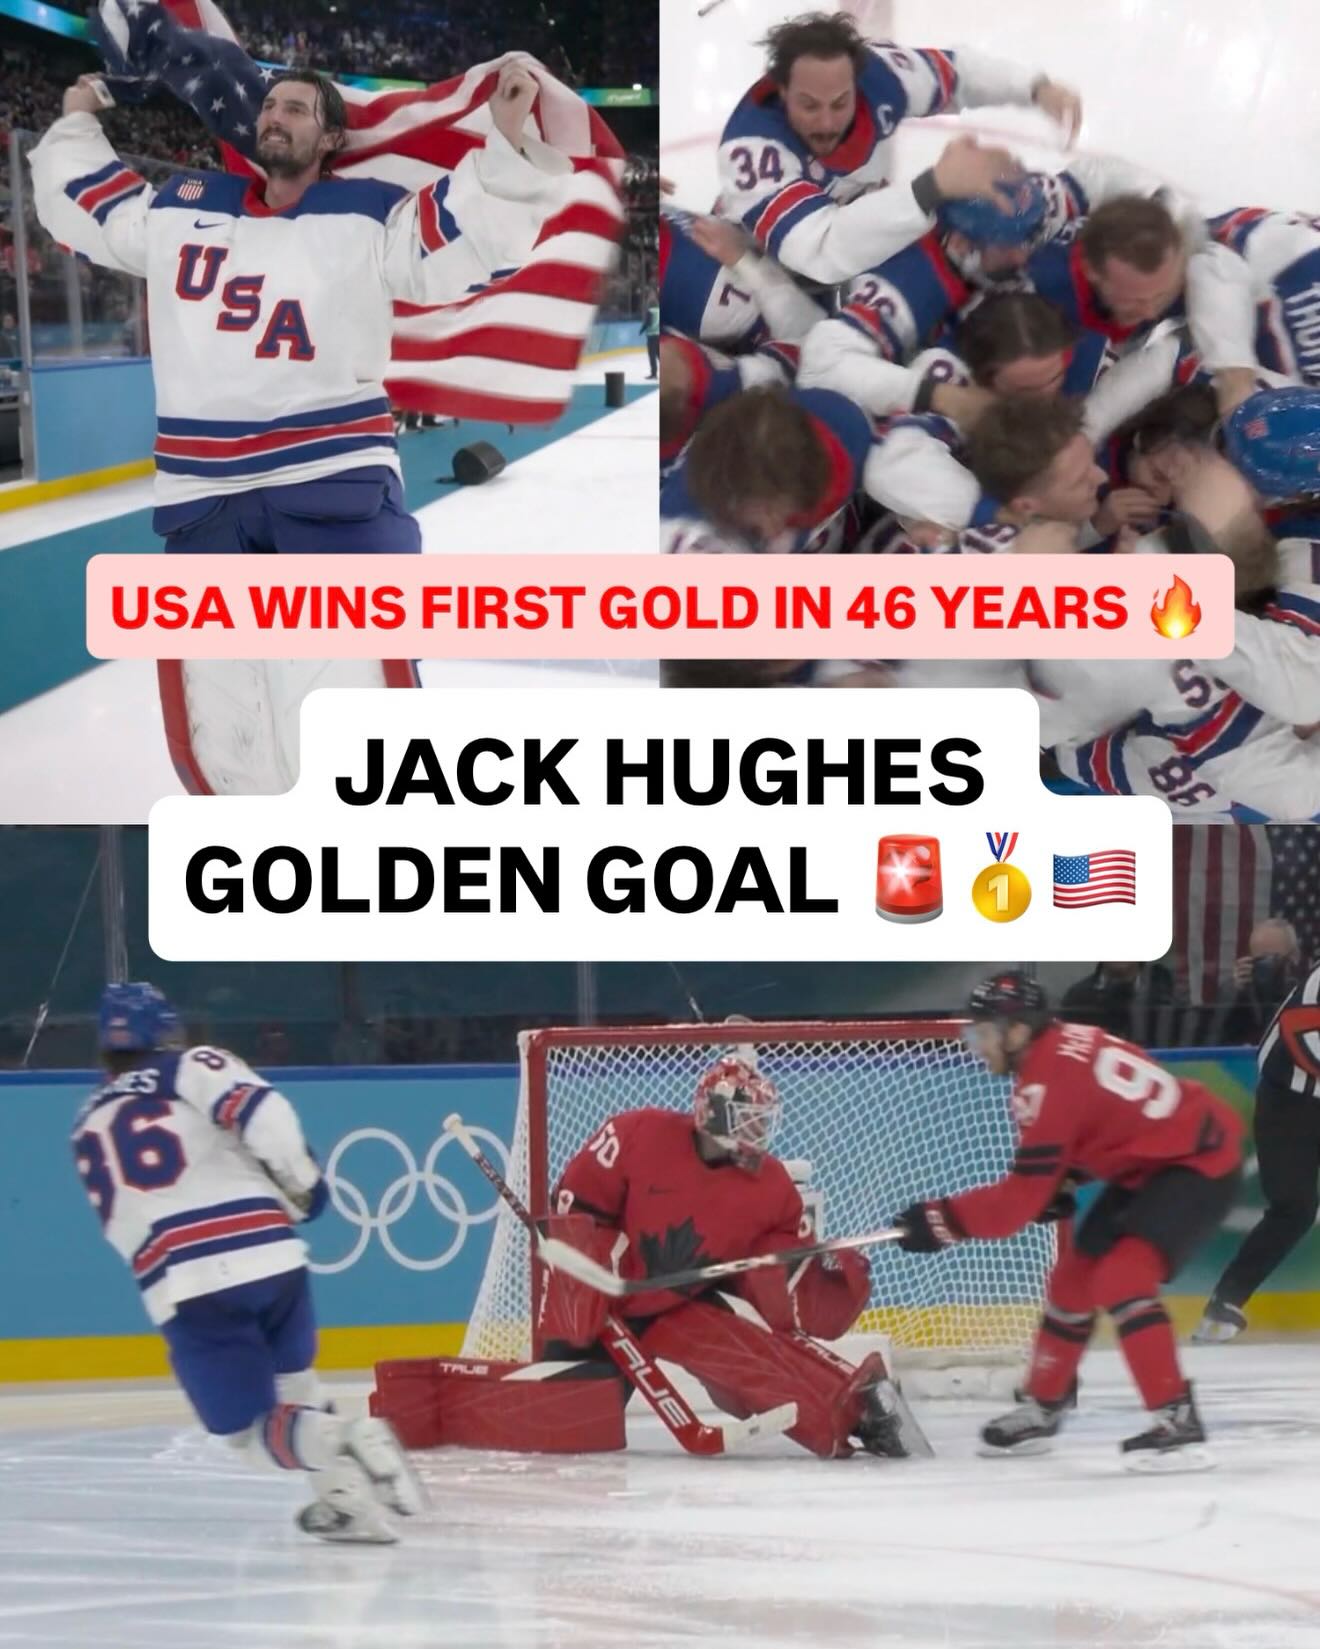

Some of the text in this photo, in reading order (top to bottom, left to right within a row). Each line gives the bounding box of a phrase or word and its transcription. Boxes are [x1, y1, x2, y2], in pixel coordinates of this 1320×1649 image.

[876, 103, 896, 136] C
[730, 145, 785, 191] 34
[175, 243, 316, 362] USA
[719, 282, 751, 307] 7
[1093, 1032, 1182, 1119] 9
[439, 1362, 489, 1375] TRUE
[606, 1315, 691, 1429] TRUE
